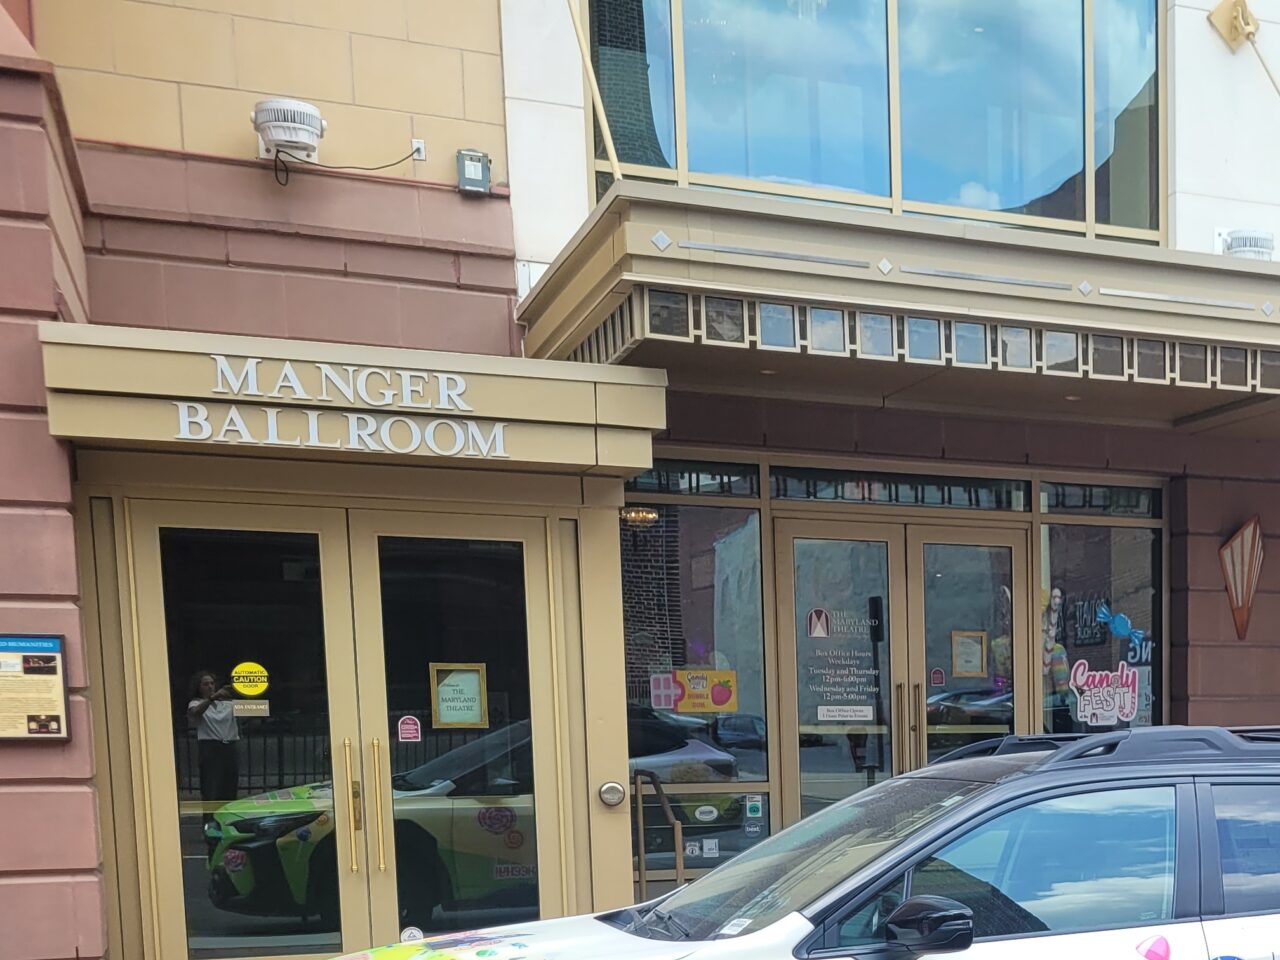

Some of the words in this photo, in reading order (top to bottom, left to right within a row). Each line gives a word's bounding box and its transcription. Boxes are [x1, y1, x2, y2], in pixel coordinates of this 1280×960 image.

[210, 354, 474, 412] MANGER
[172, 401, 511, 459] BALLROOM
[1072, 661, 1137, 692] Candy
[1080, 687, 1130, 712] FEST
